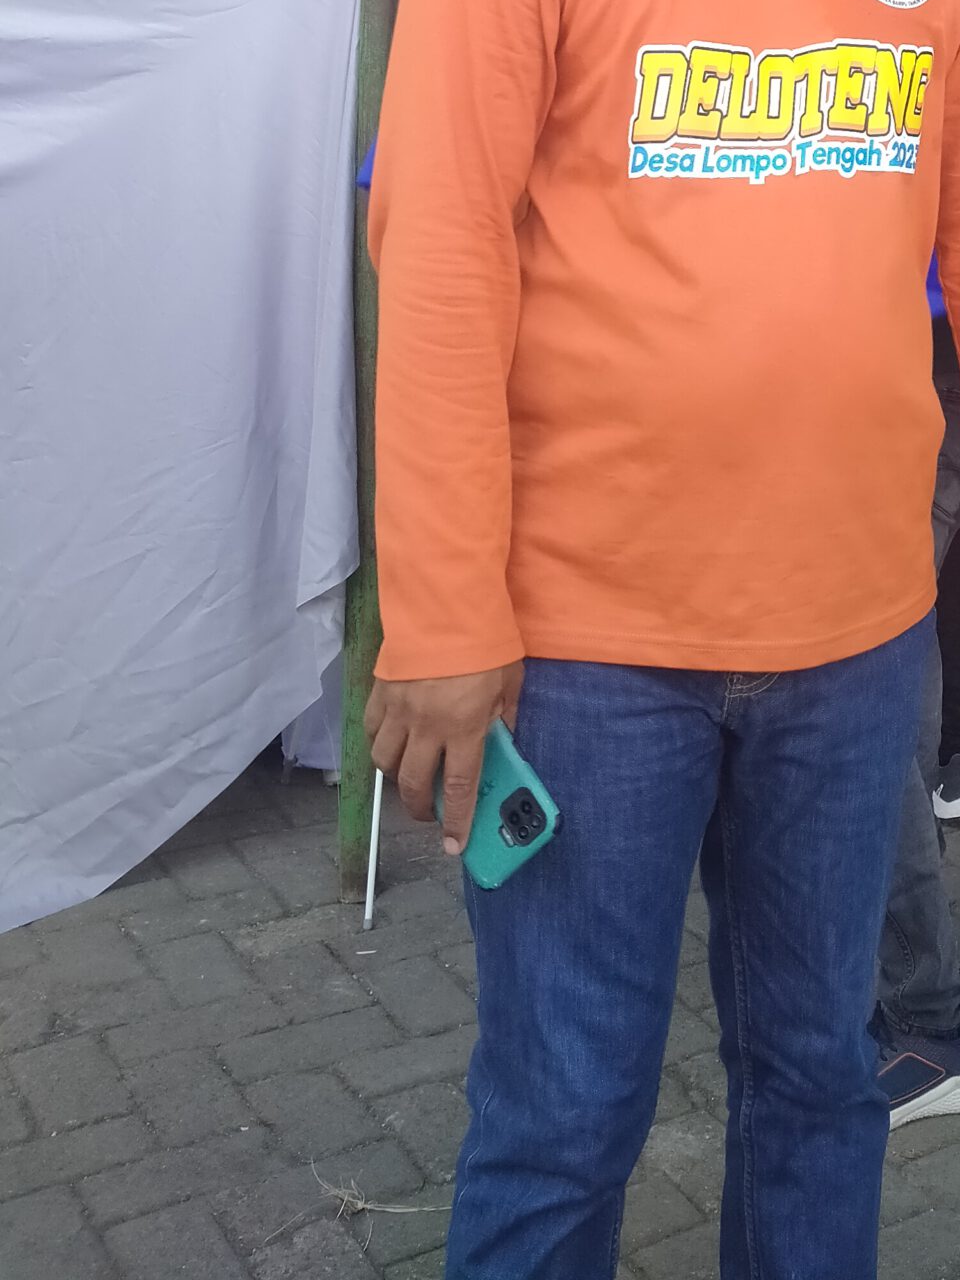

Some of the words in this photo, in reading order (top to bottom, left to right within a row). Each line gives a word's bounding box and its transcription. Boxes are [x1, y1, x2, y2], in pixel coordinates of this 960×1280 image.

[632, 42, 933, 145] DELOTENG
[630, 145, 695, 173] Desa
[701, 145, 788, 179] Lompo
[796, 139, 882, 173] Tengah
